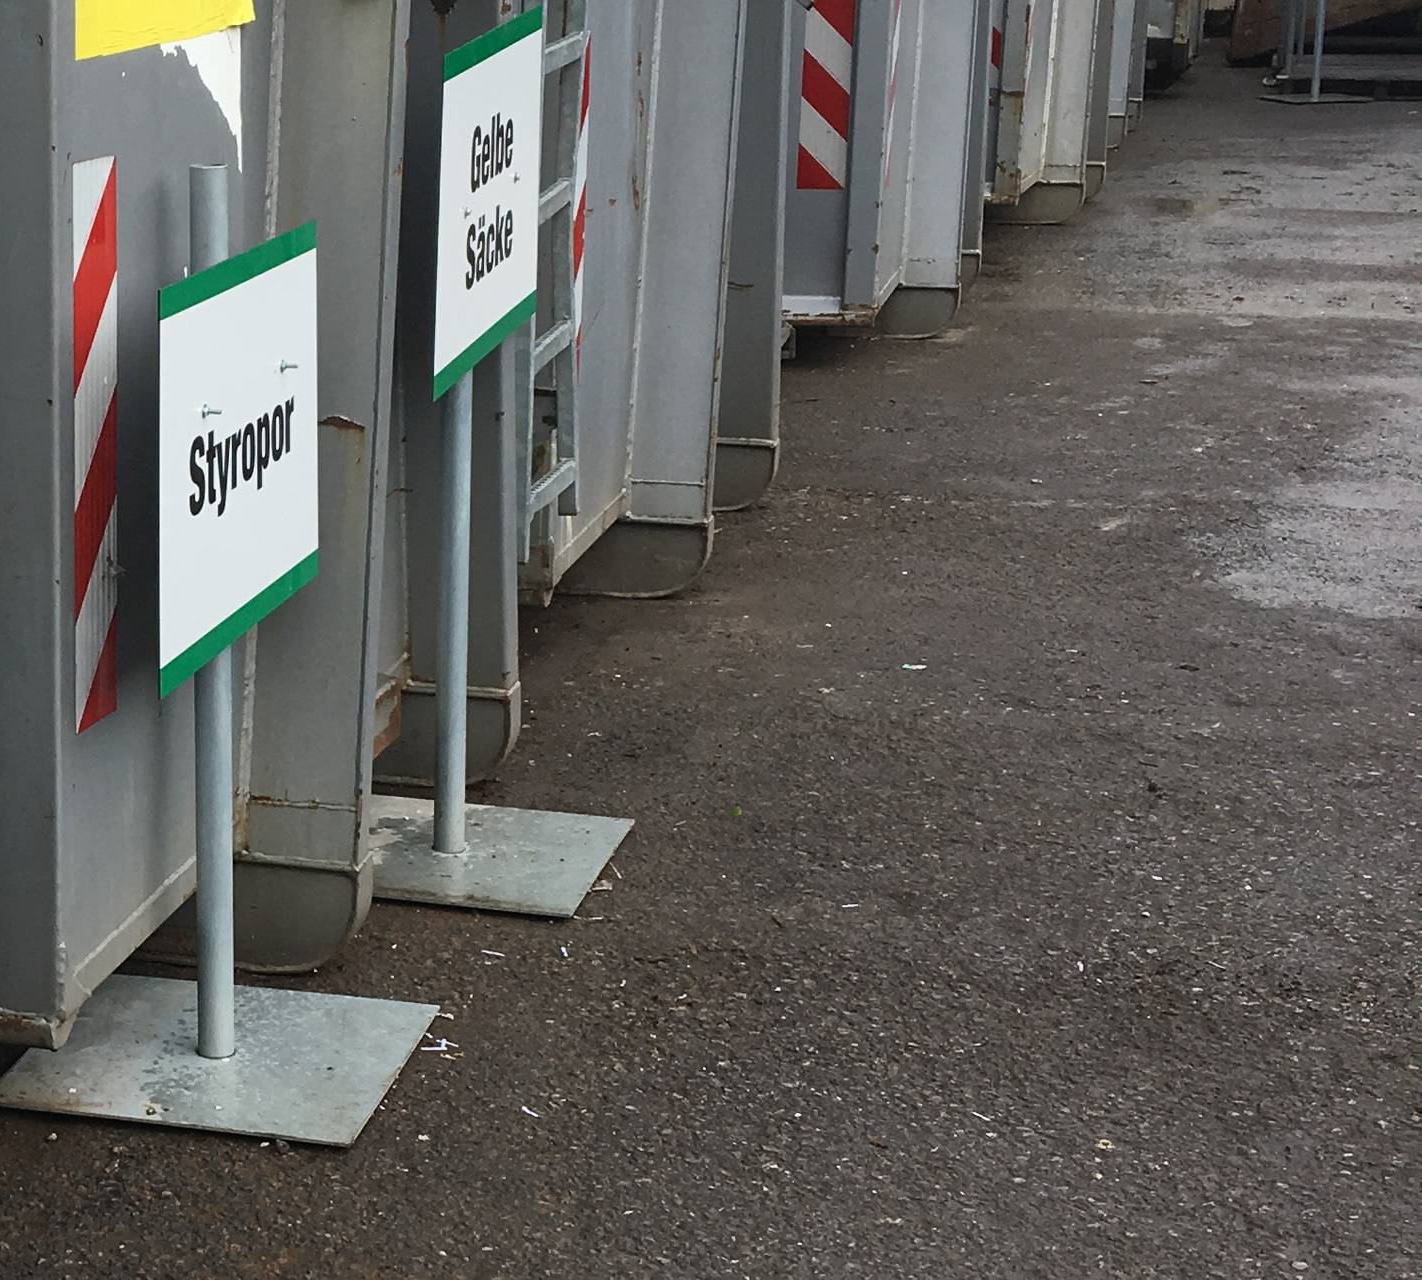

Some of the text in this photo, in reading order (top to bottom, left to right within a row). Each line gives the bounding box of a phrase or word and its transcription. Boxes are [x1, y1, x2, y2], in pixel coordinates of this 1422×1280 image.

[471, 112, 514, 193] Gelbe
[465, 204, 514, 290] Säcke
[189, 395, 294, 517] Styropor
